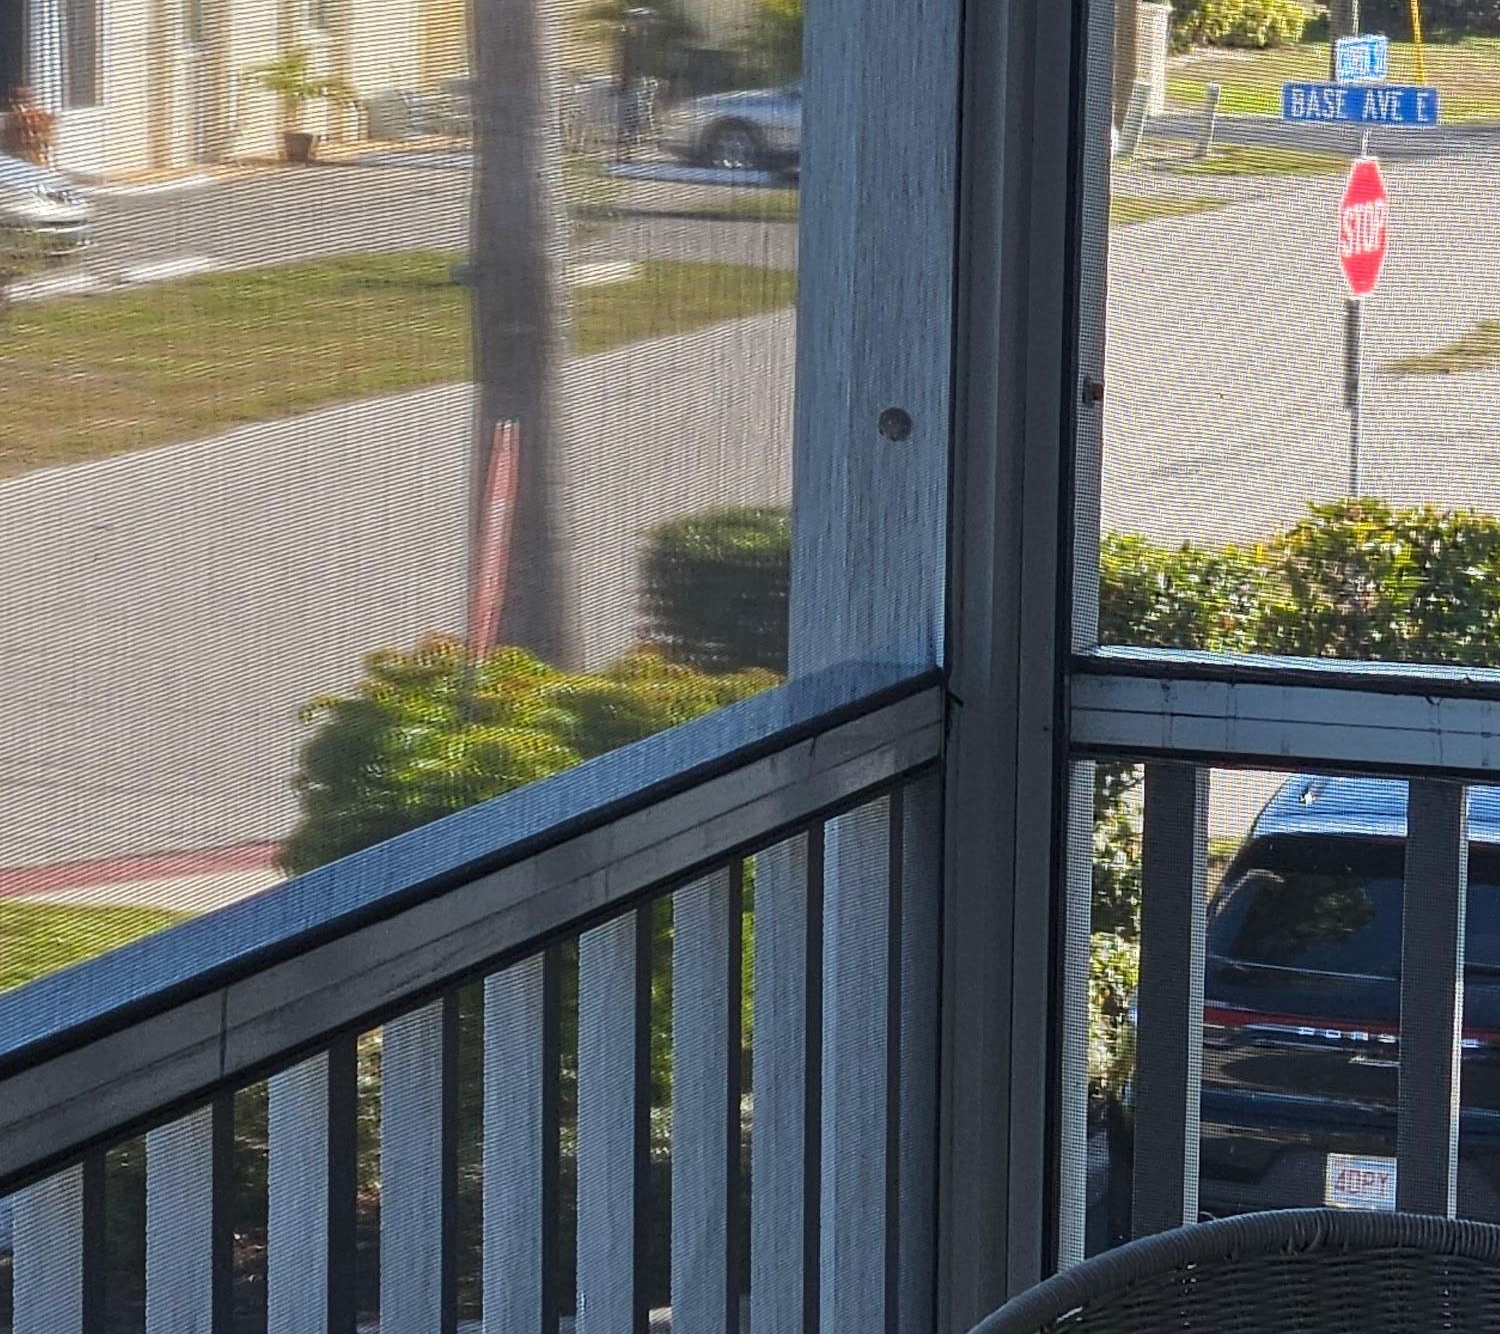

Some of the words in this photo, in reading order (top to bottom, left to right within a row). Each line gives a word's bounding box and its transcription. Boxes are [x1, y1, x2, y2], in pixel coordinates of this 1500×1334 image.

[1291, 88, 1348, 119] BASE
[1362, 90, 1403, 122] AVE
[1416, 92, 1430, 122] E
[1341, 199, 1388, 258] STOP
